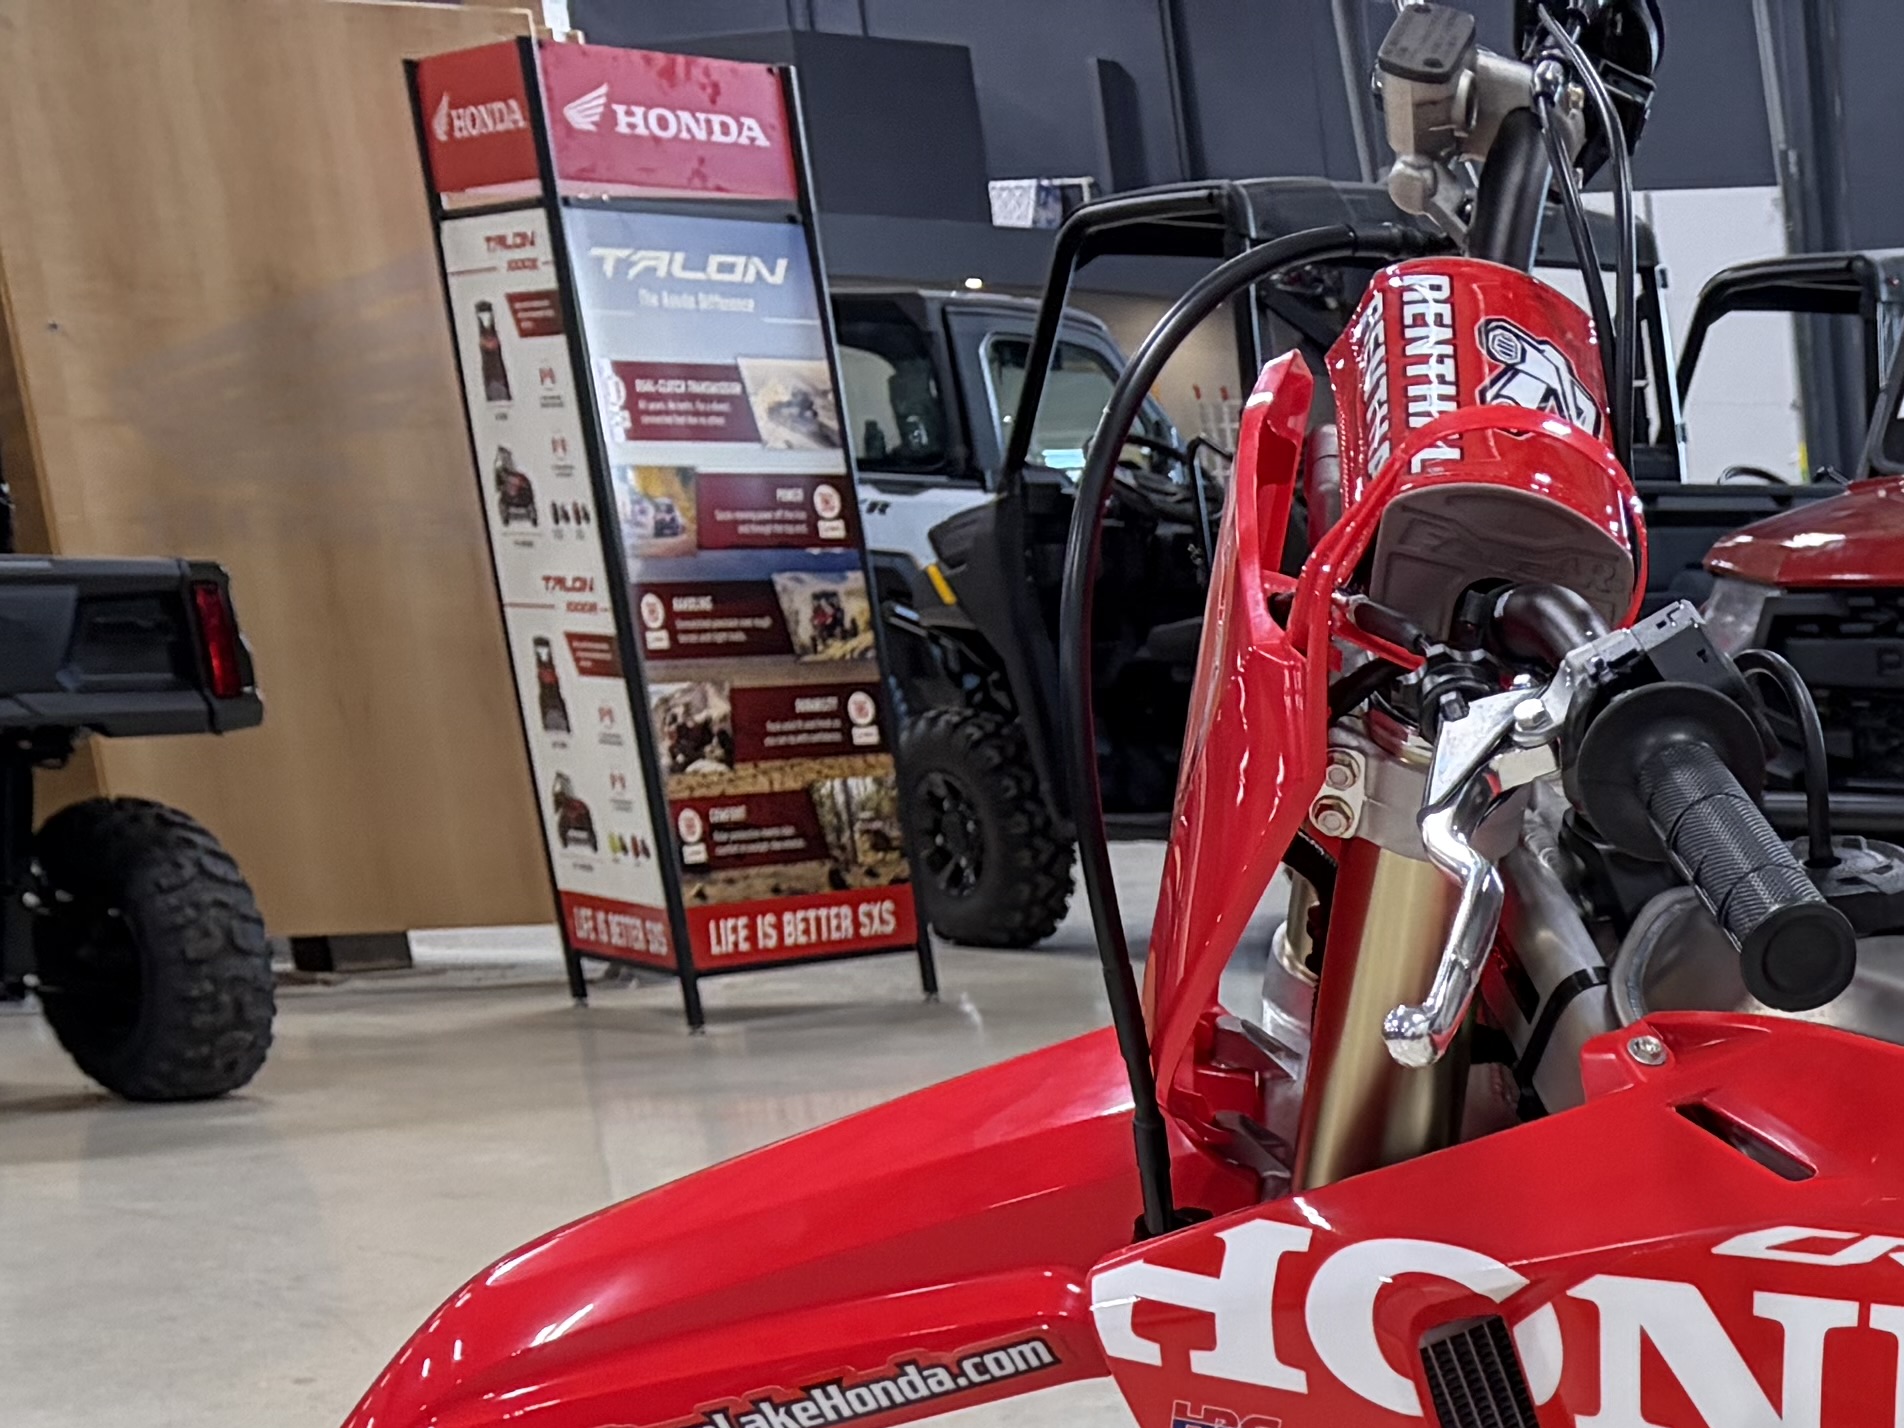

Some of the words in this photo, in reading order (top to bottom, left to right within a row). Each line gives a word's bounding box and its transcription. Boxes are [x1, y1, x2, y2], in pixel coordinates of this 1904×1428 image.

[449, 100, 528, 139] HONDA
[612, 103, 770, 147] HONDA
[485, 231, 535, 252] TALON
[590, 247, 788, 285] TALON
[542, 575, 595, 592] TALON
[709, 915, 751, 955] LIFE
[757, 914, 778, 948] IS
[783, 905, 854, 946] BETTER
[859, 900, 896, 936] SXS
